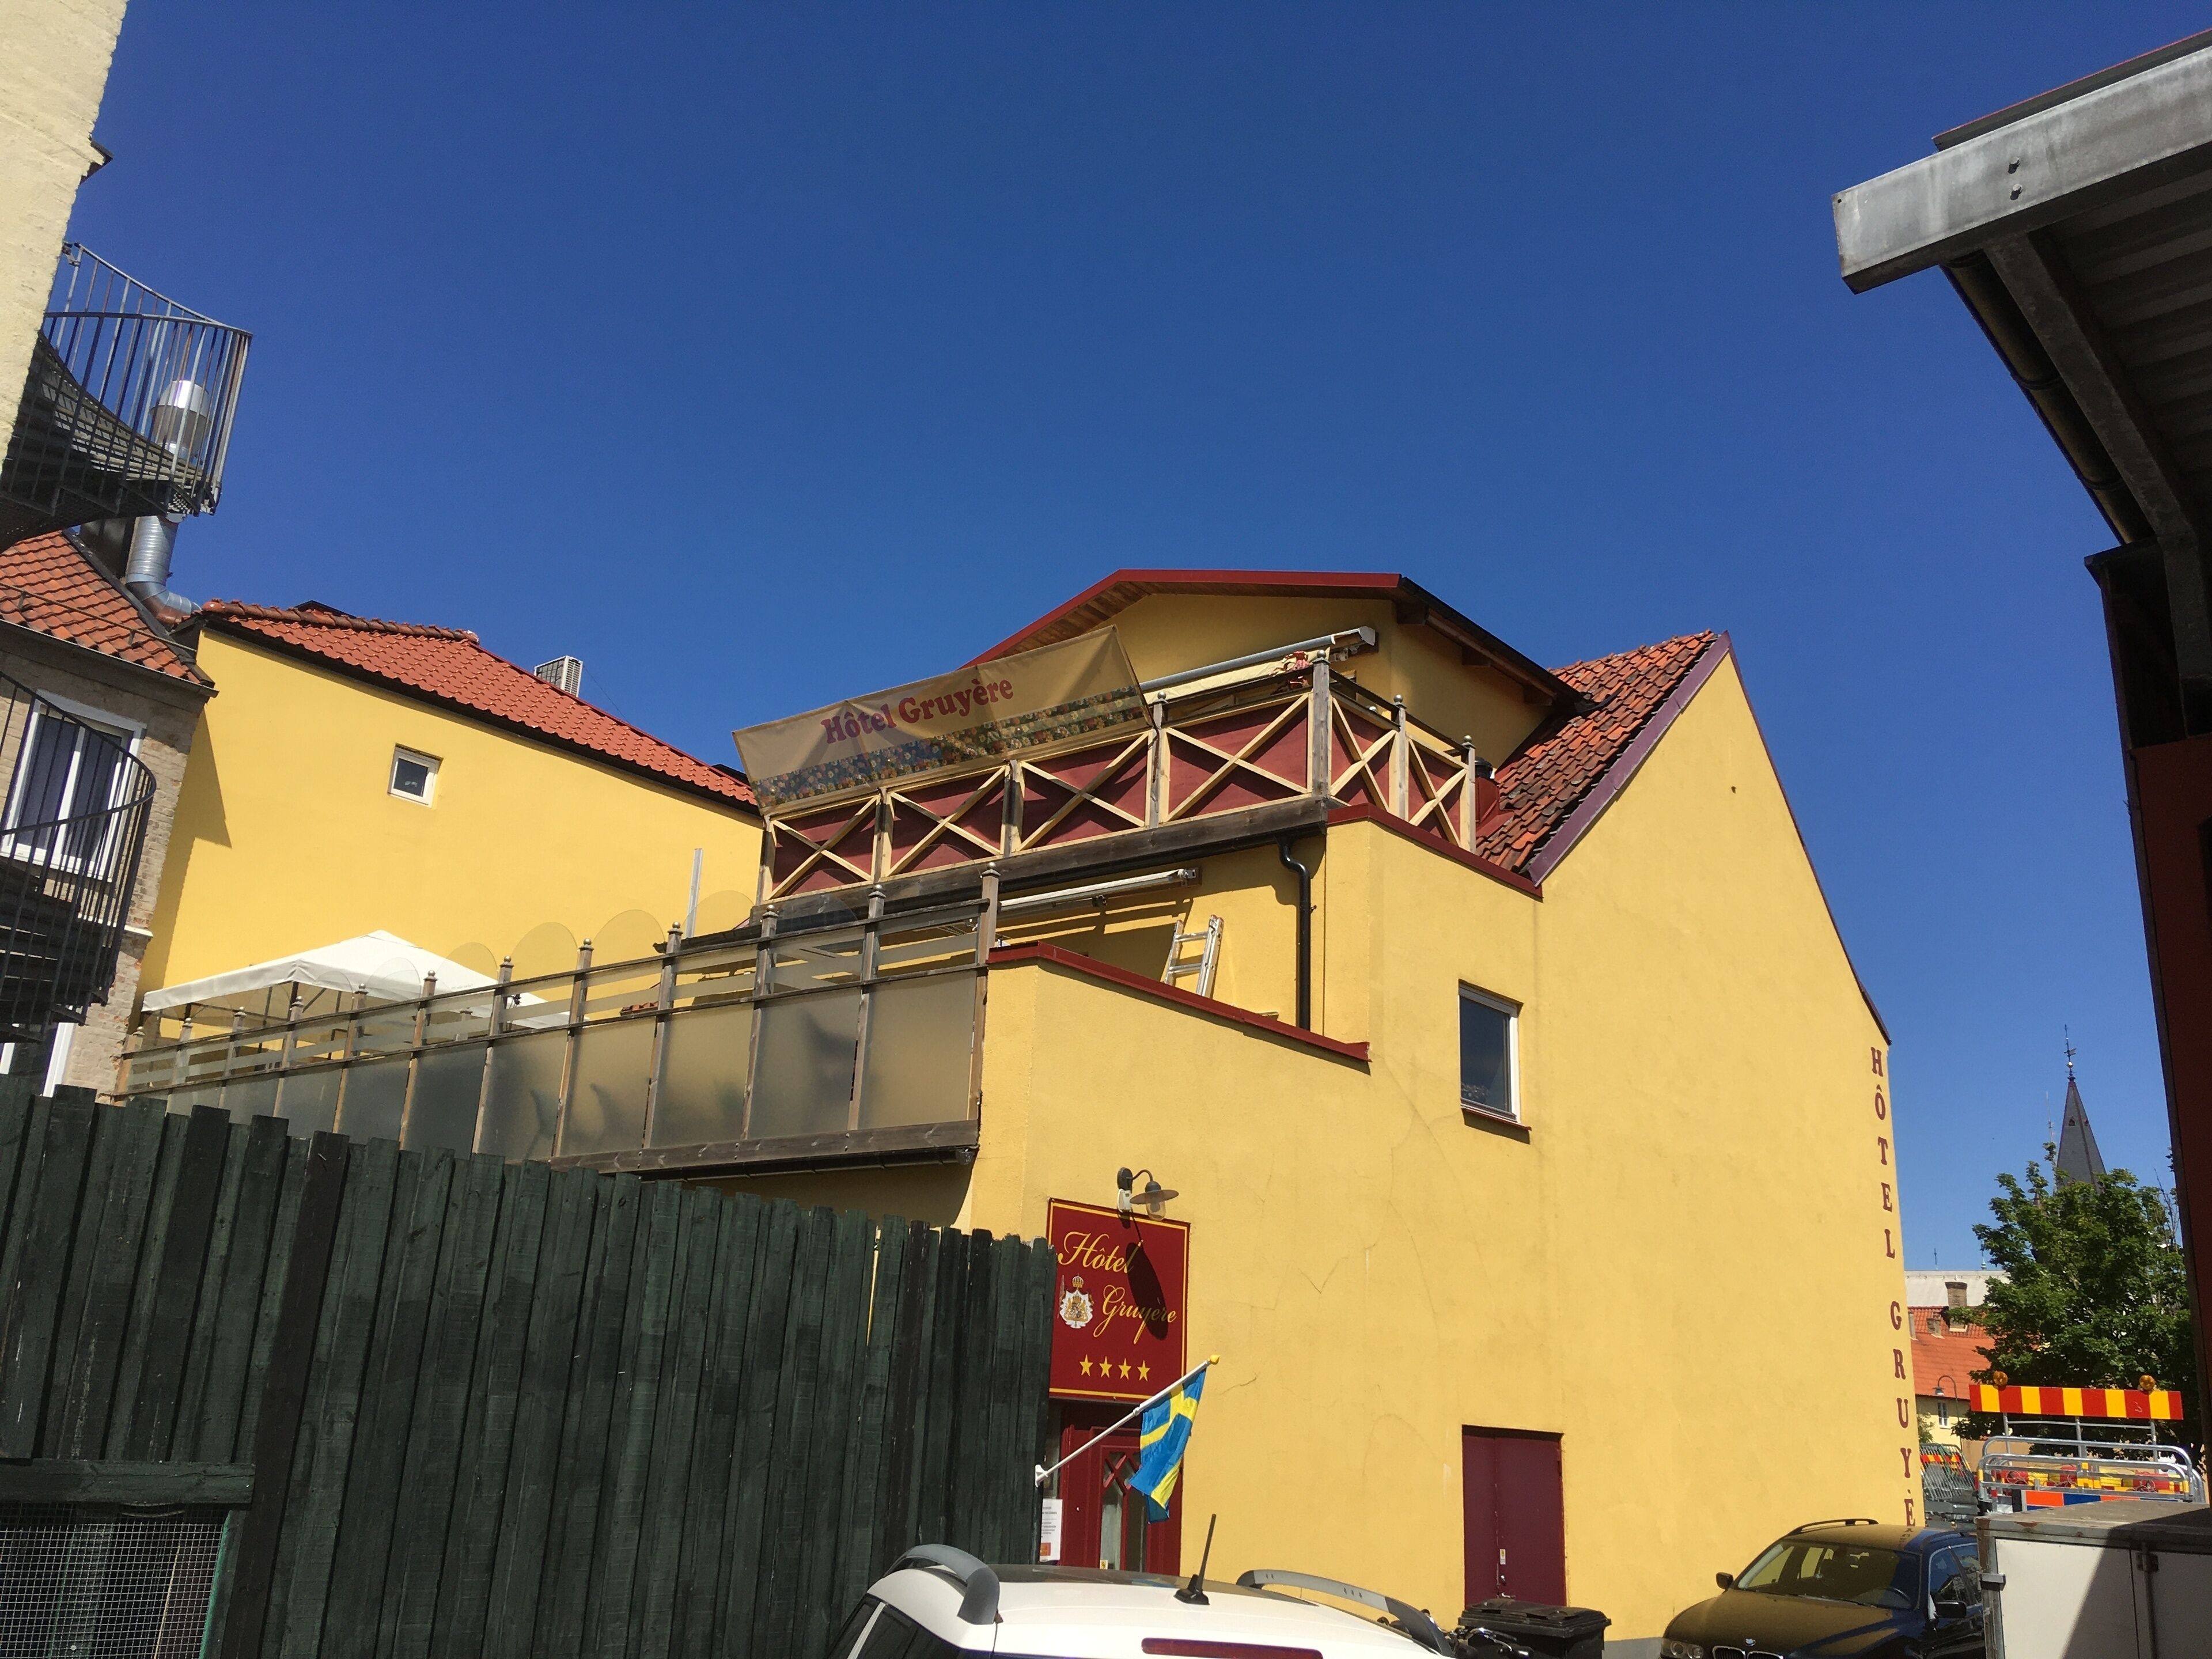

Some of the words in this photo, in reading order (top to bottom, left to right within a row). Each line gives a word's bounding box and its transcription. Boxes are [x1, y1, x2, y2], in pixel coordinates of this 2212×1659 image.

[821, 703, 897, 744] Hôtel
[899, 678, 1013, 724] Gruyère
[1870, 1047, 1895, 1259] HÔTEL
[1058, 1232, 1143, 1273] Hôtel
